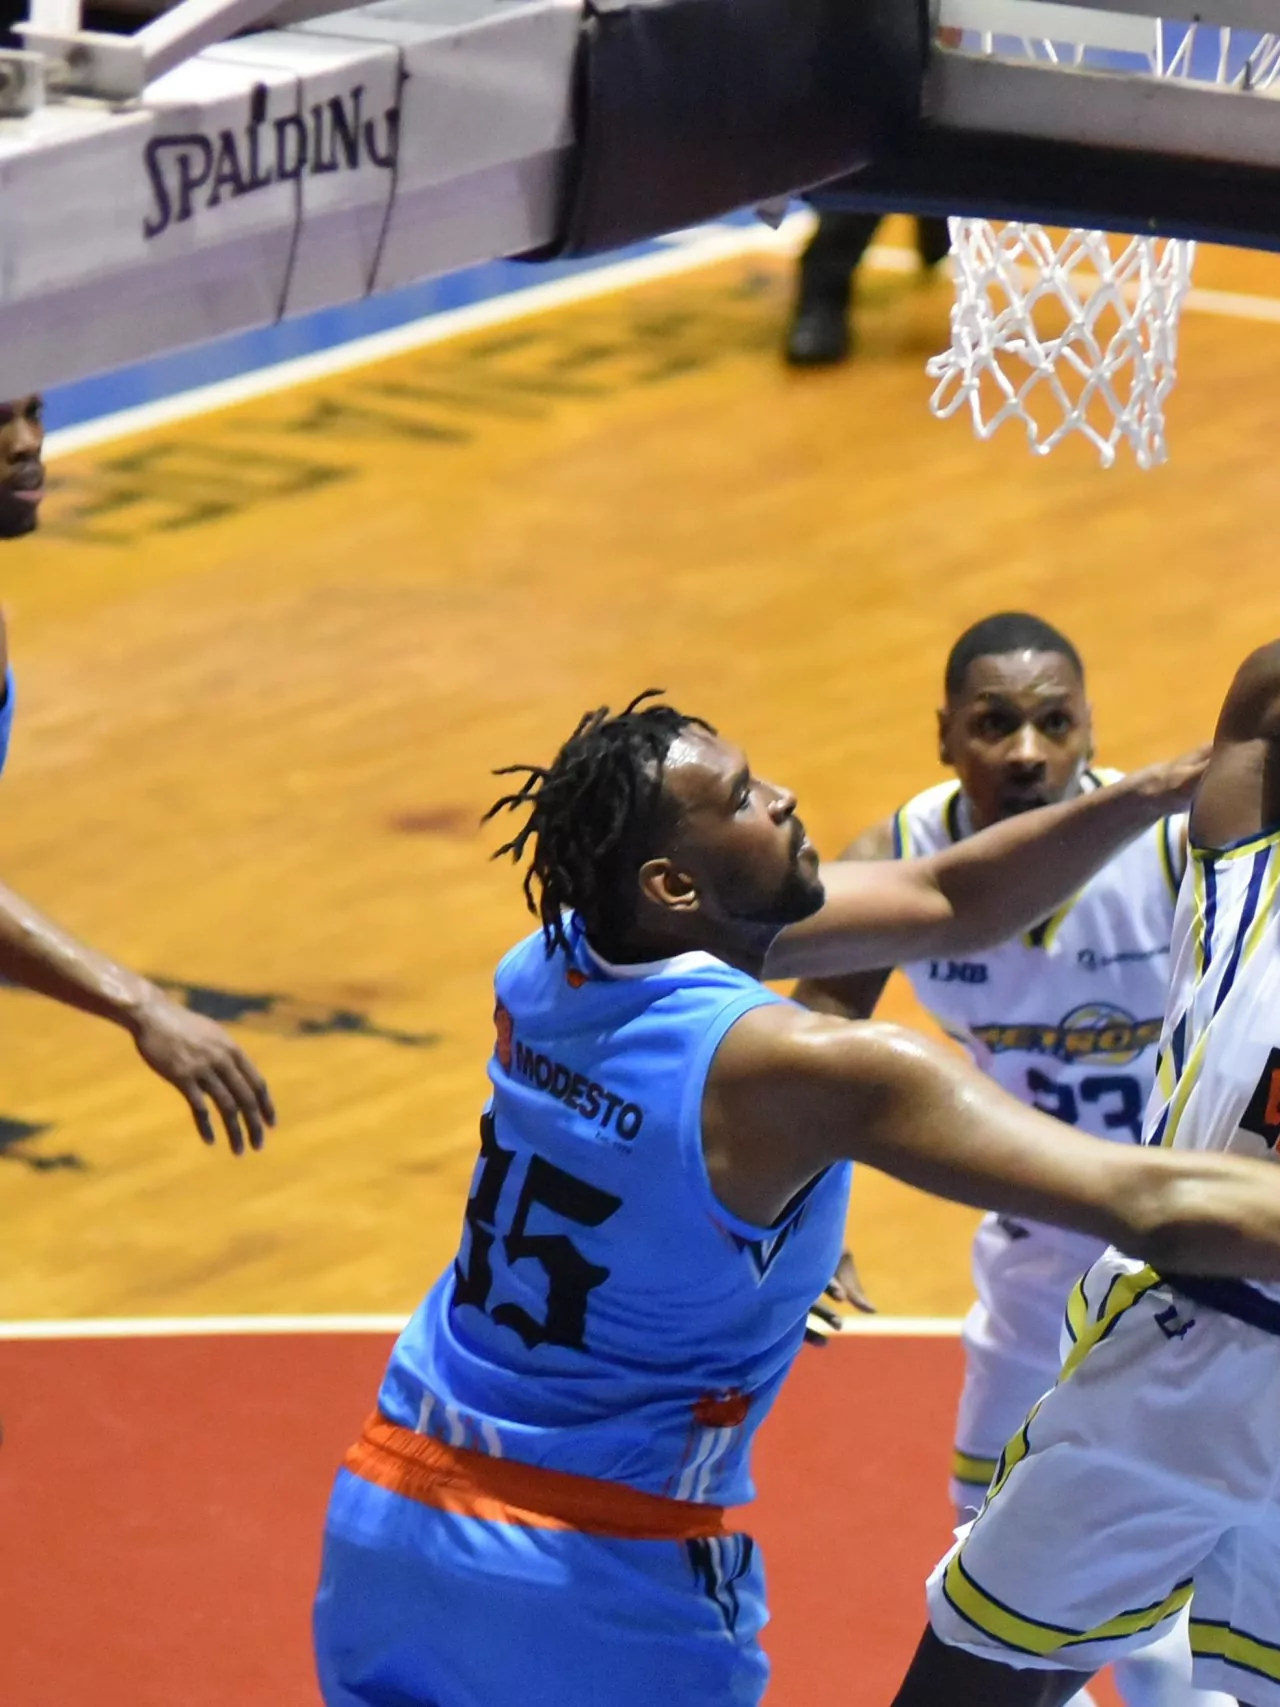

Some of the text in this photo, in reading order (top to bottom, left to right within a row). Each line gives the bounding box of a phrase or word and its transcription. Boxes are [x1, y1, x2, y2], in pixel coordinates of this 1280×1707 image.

[143, 84, 400, 240] SPALDING
[929, 960, 988, 984] LNB
[516, 1041, 643, 1141] MODESTO
